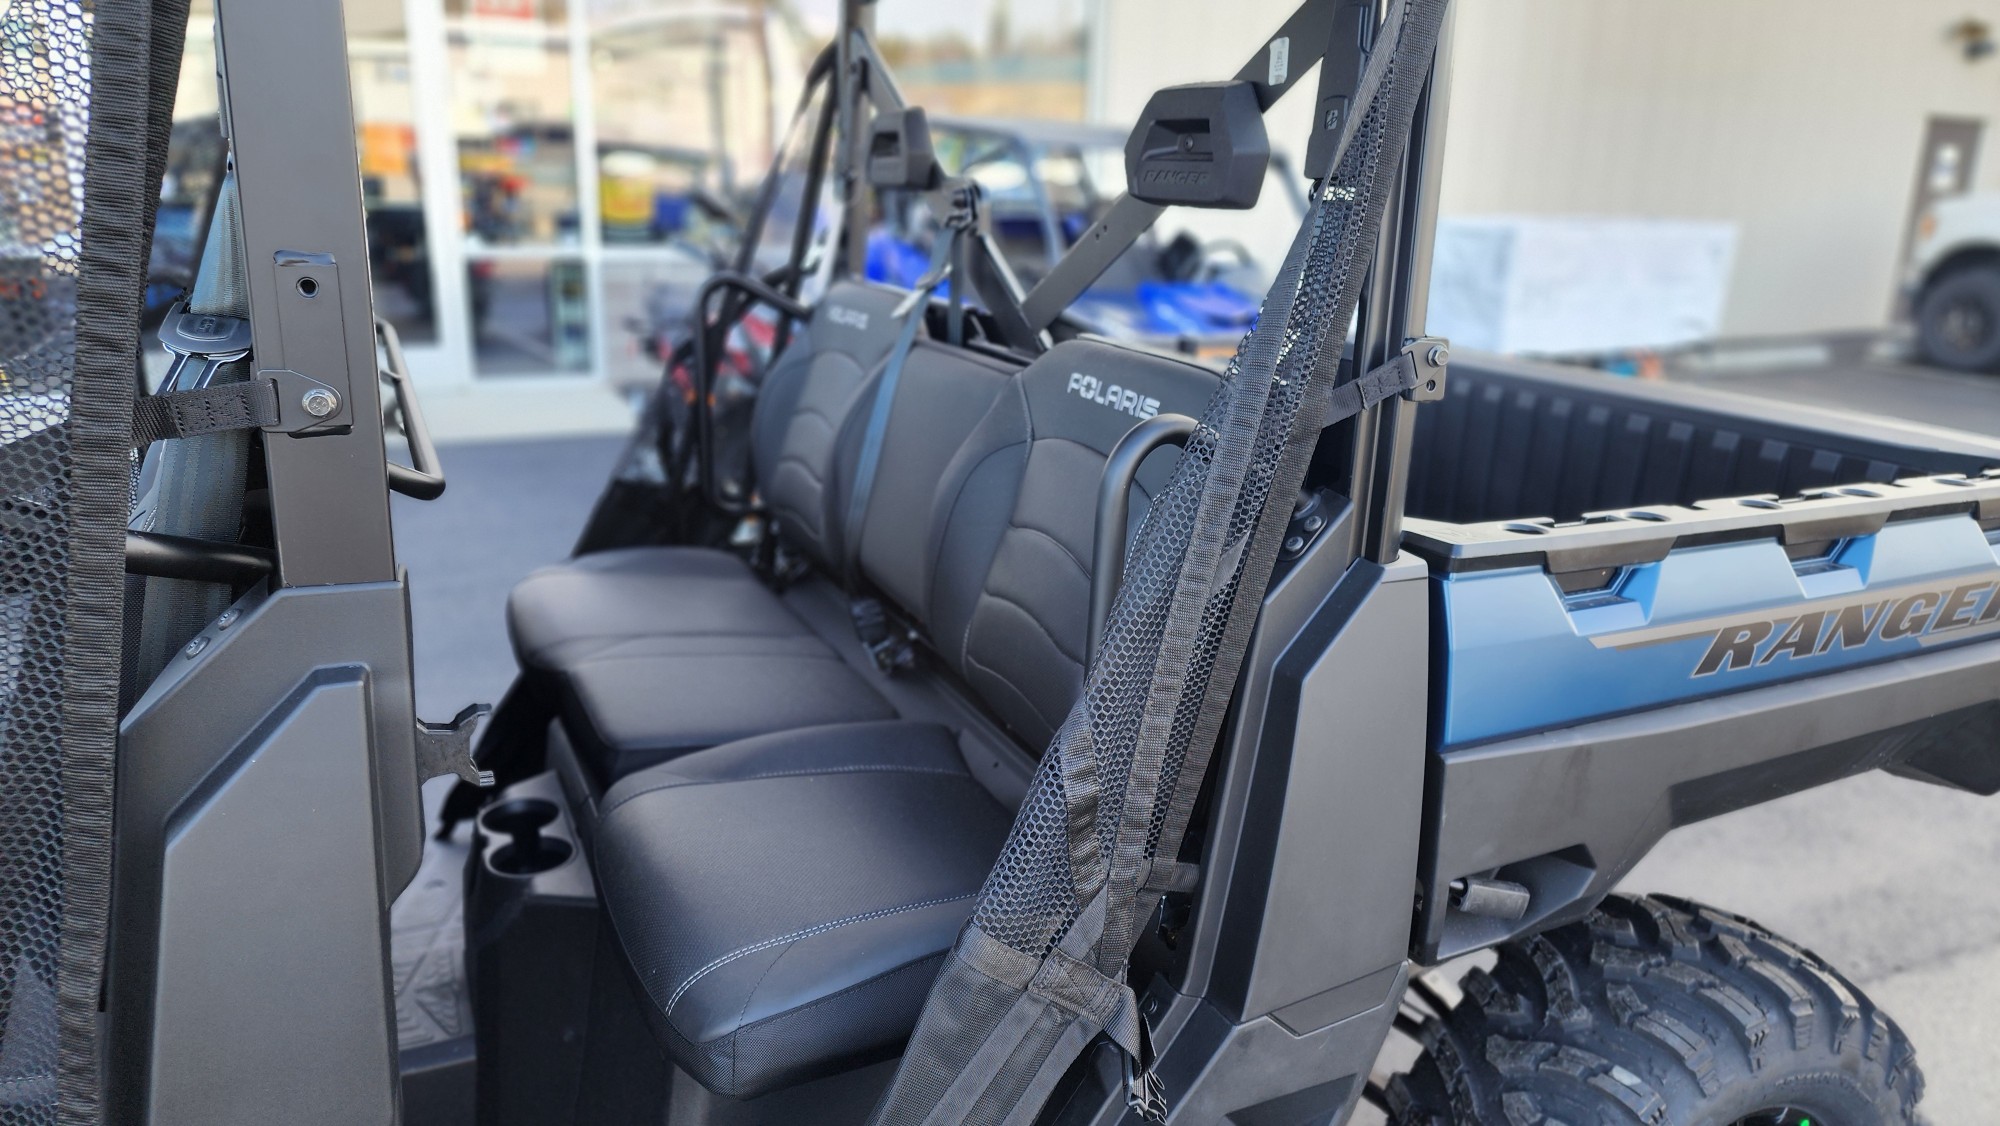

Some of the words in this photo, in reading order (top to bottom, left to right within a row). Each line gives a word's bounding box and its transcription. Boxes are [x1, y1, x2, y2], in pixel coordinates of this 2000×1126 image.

[1143, 168, 1210, 185] RANGER
[1066, 372, 1161, 421] POLARIS
[1690, 580, 2000, 679] RANGE
